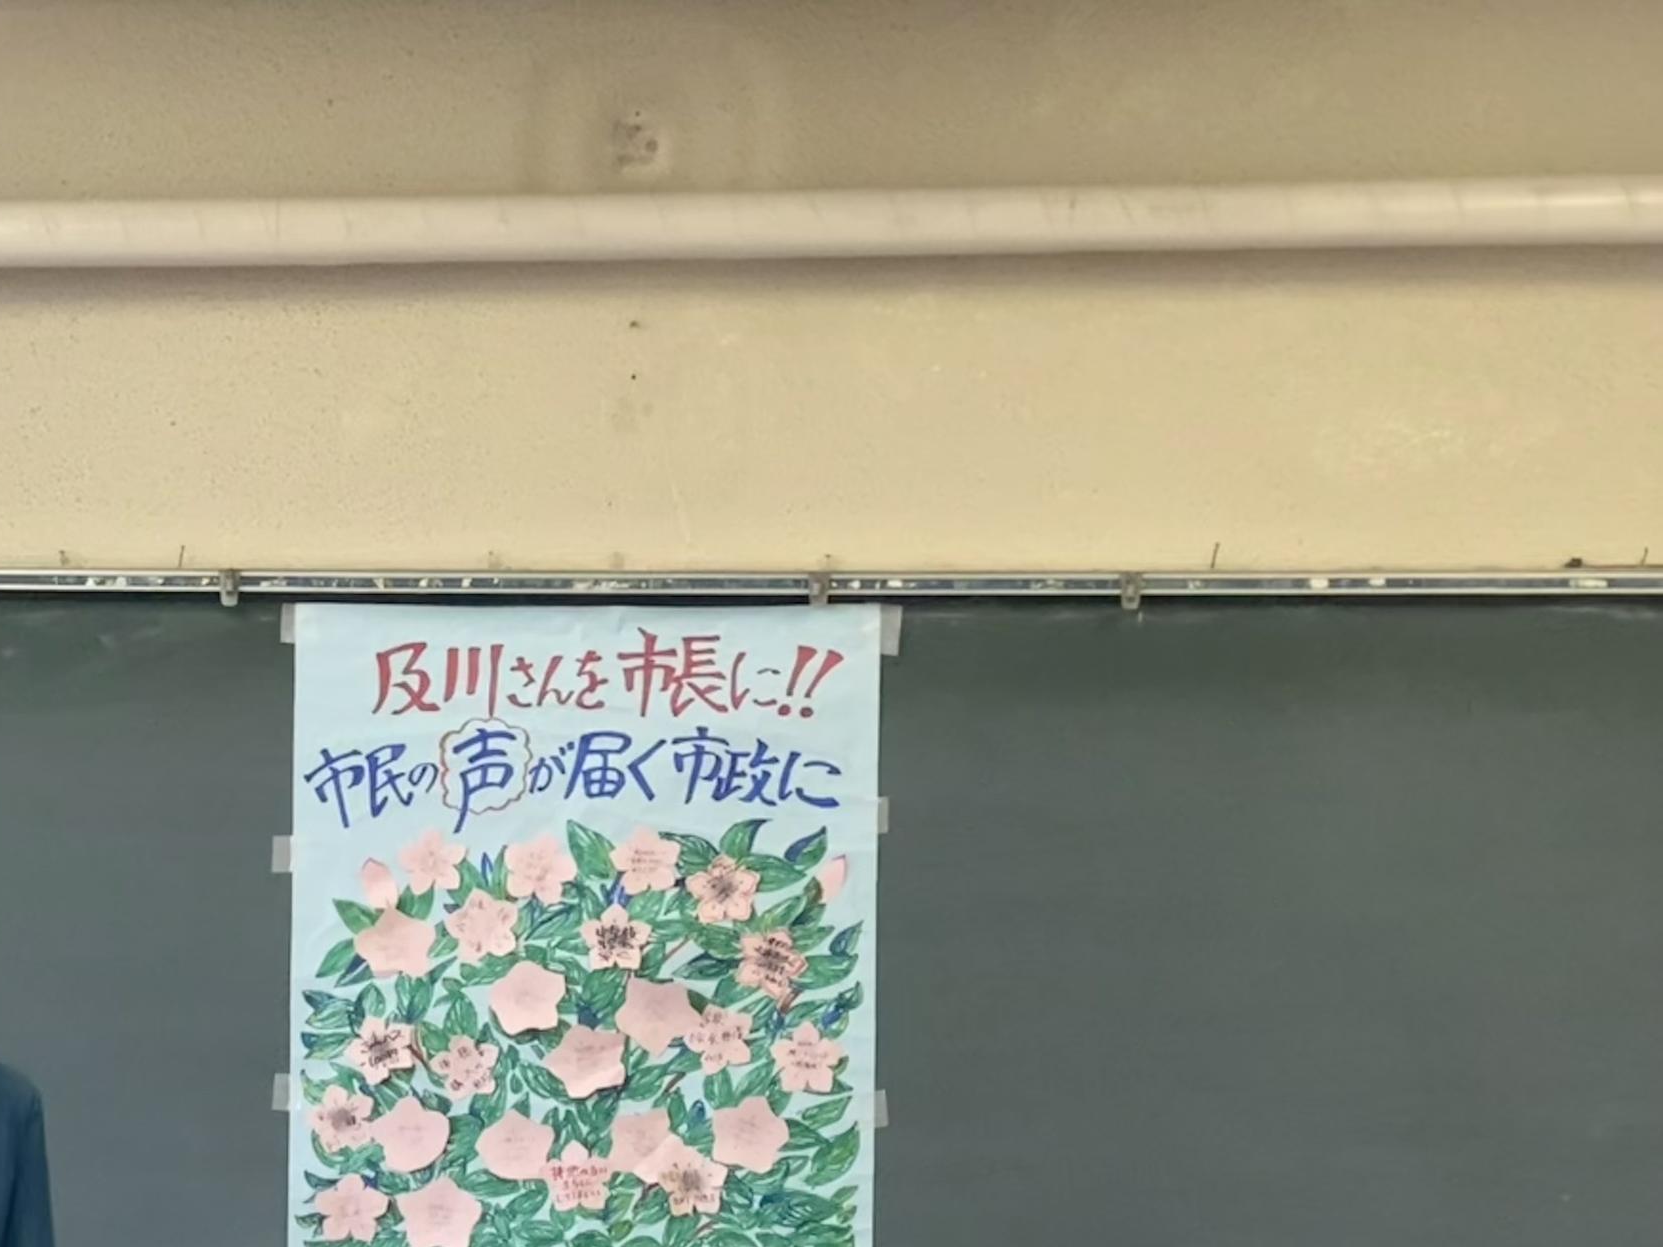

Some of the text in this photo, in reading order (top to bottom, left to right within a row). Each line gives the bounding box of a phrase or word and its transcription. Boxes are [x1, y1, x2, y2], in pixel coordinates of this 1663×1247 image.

[372, 627, 845, 718] 及川さんを市長に!!
[304, 727, 842, 834] 市民の声が届く市政に
